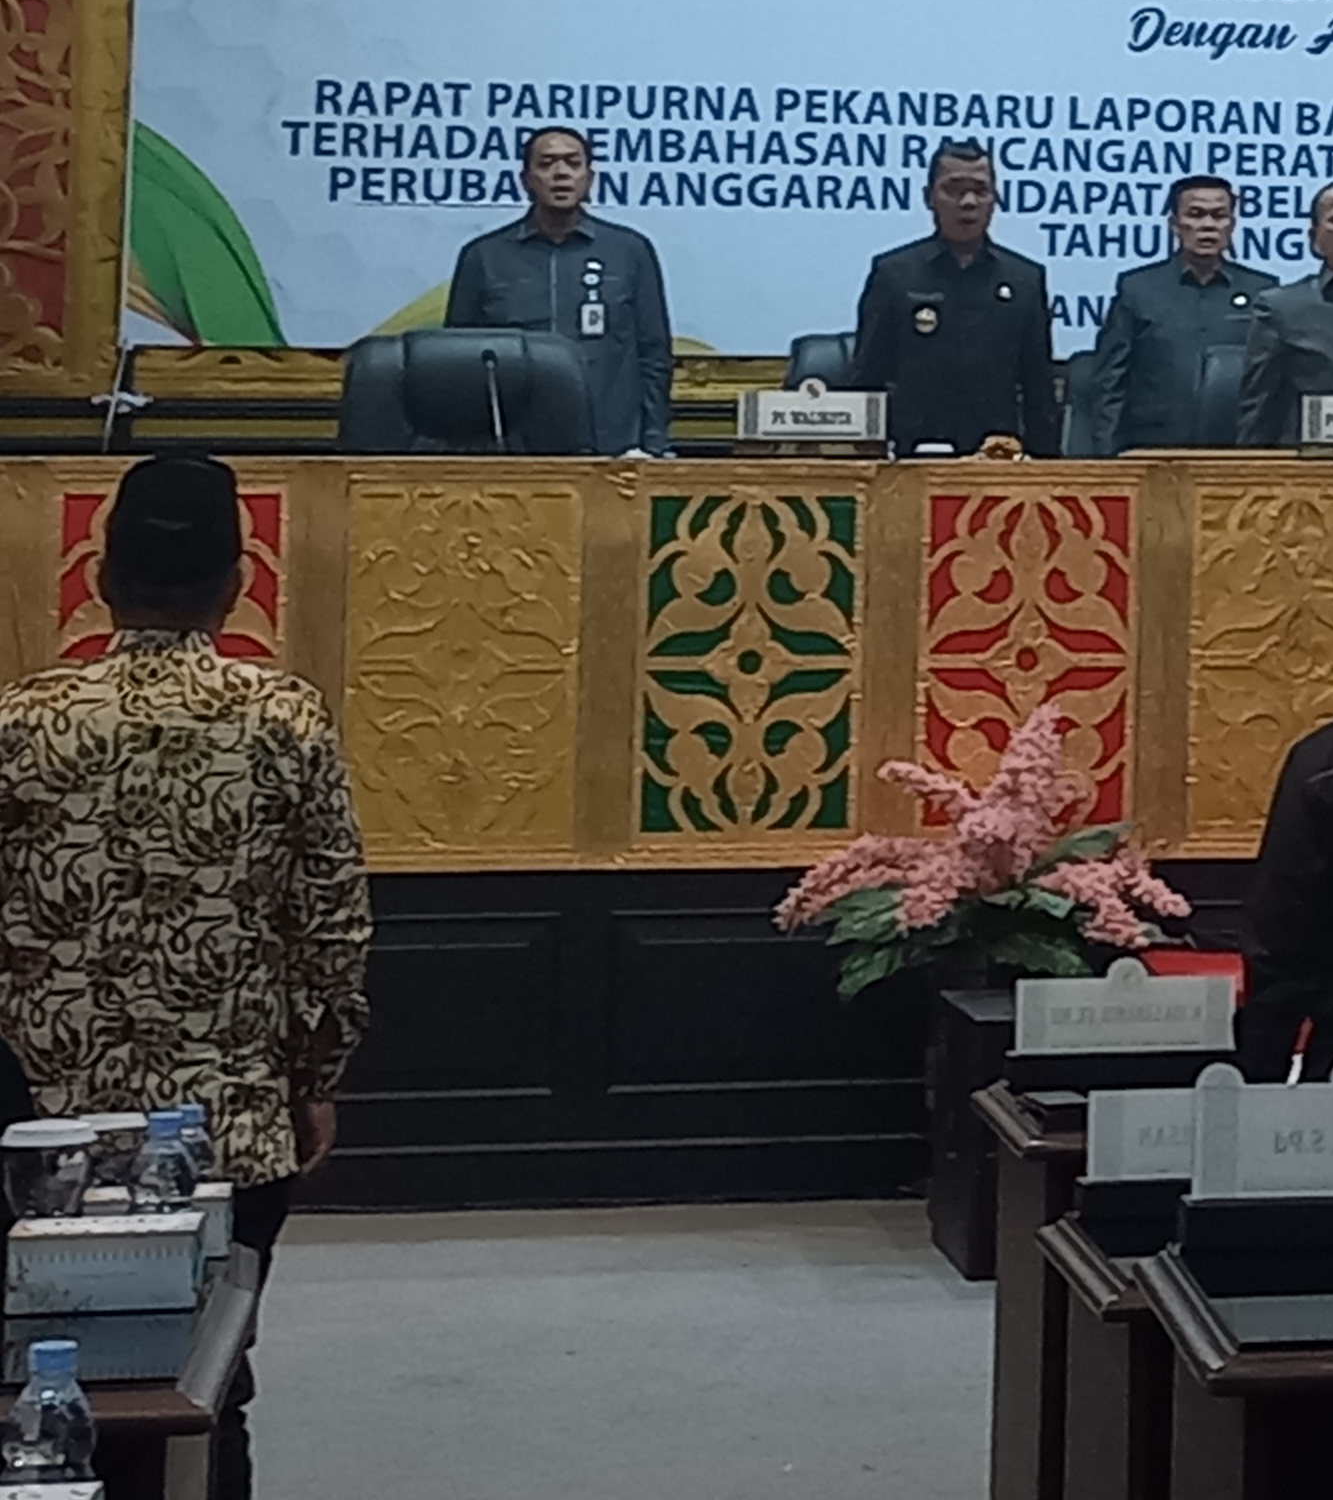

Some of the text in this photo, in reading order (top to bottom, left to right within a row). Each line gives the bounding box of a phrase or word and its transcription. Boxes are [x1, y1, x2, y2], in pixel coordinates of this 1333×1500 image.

[1128, 7, 1296, 60] Dengan
[315, 79, 472, 118] RAPAT
[487, 82, 760, 122] PARIPURNA
[775, 88, 1054, 129] PEKANBARU
[1069, 96, 1281, 135] LAPORAN
[585, 127, 886, 168] EMBAHASAN
[902, 134, 1192, 176] RCANGAN
[329, 166, 628, 206] PERUBAN
[638, 172, 911, 212] ANGGARAN
